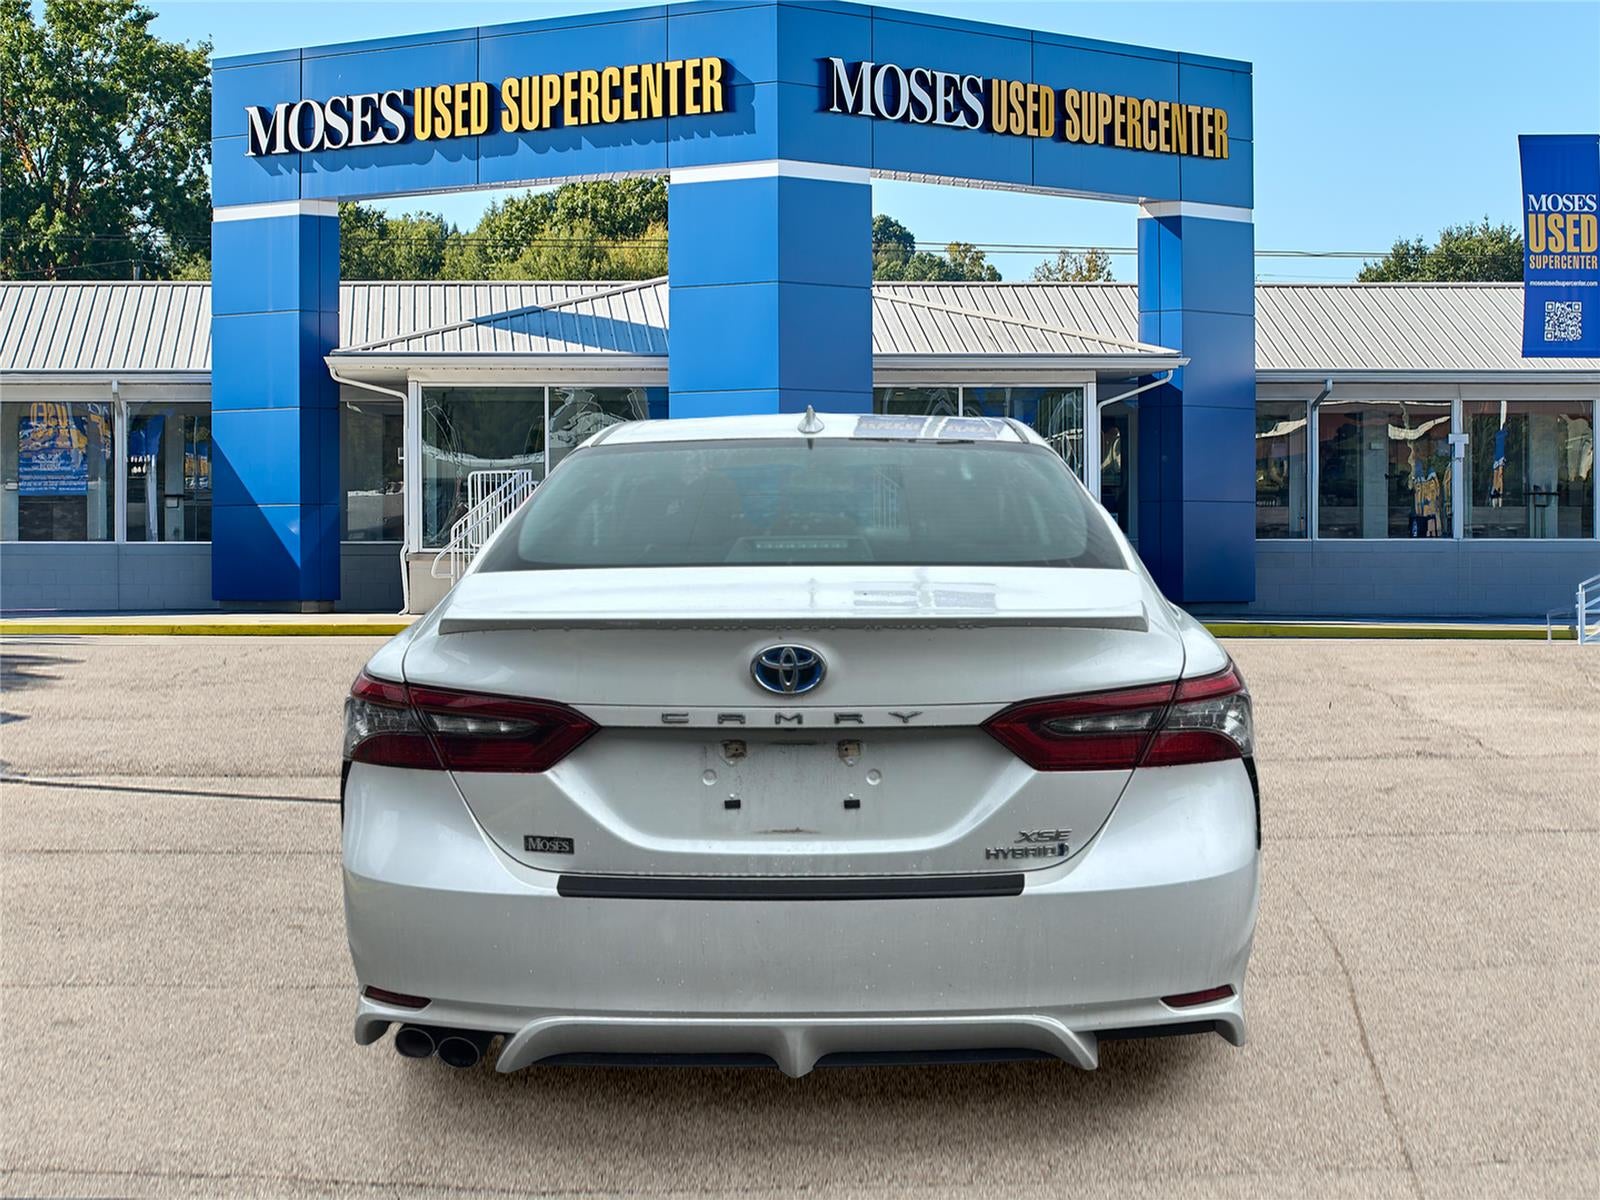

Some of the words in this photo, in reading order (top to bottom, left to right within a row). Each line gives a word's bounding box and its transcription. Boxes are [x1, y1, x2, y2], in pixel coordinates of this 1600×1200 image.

[245, 89, 406, 157] MOSES
[413, 81, 489, 141] USED
[500, 56, 725, 133] SUPERCENTER
[828, 57, 985, 130] MOSES
[991, 78, 1055, 138] USED
[1065, 88, 1229, 160] SUPERCENTER
[1527, 193, 1598, 212] MOSES
[1528, 213, 1598, 253] USED
[1529, 254, 1598, 270] SUPERCENTER
[661, 711, 923, 725] CAMRY
[1014, 828, 1073, 843] XSE
[528, 837, 570, 851] MOSES
[985, 846, 1058, 860] HYBRID
